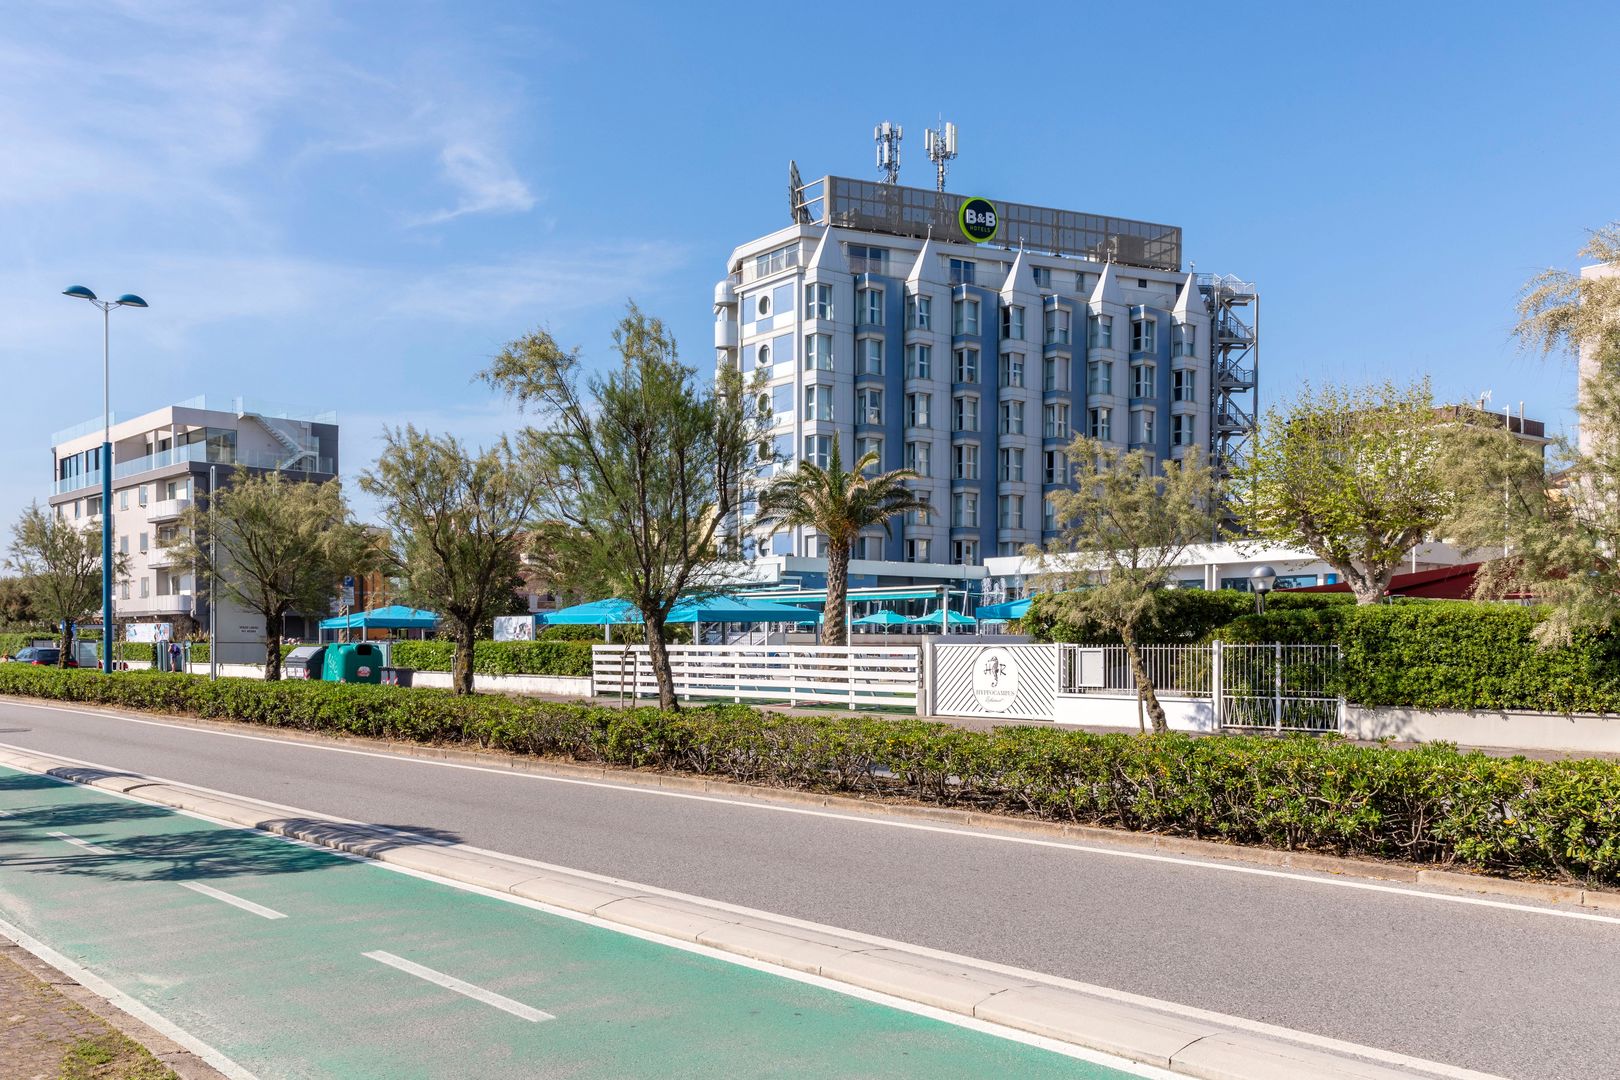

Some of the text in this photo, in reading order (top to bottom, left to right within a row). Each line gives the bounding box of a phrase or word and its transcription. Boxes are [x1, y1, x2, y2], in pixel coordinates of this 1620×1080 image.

[966, 209, 996, 227] B&B
[970, 225, 991, 233] HOTELS
[344, 575, 352, 585] P
